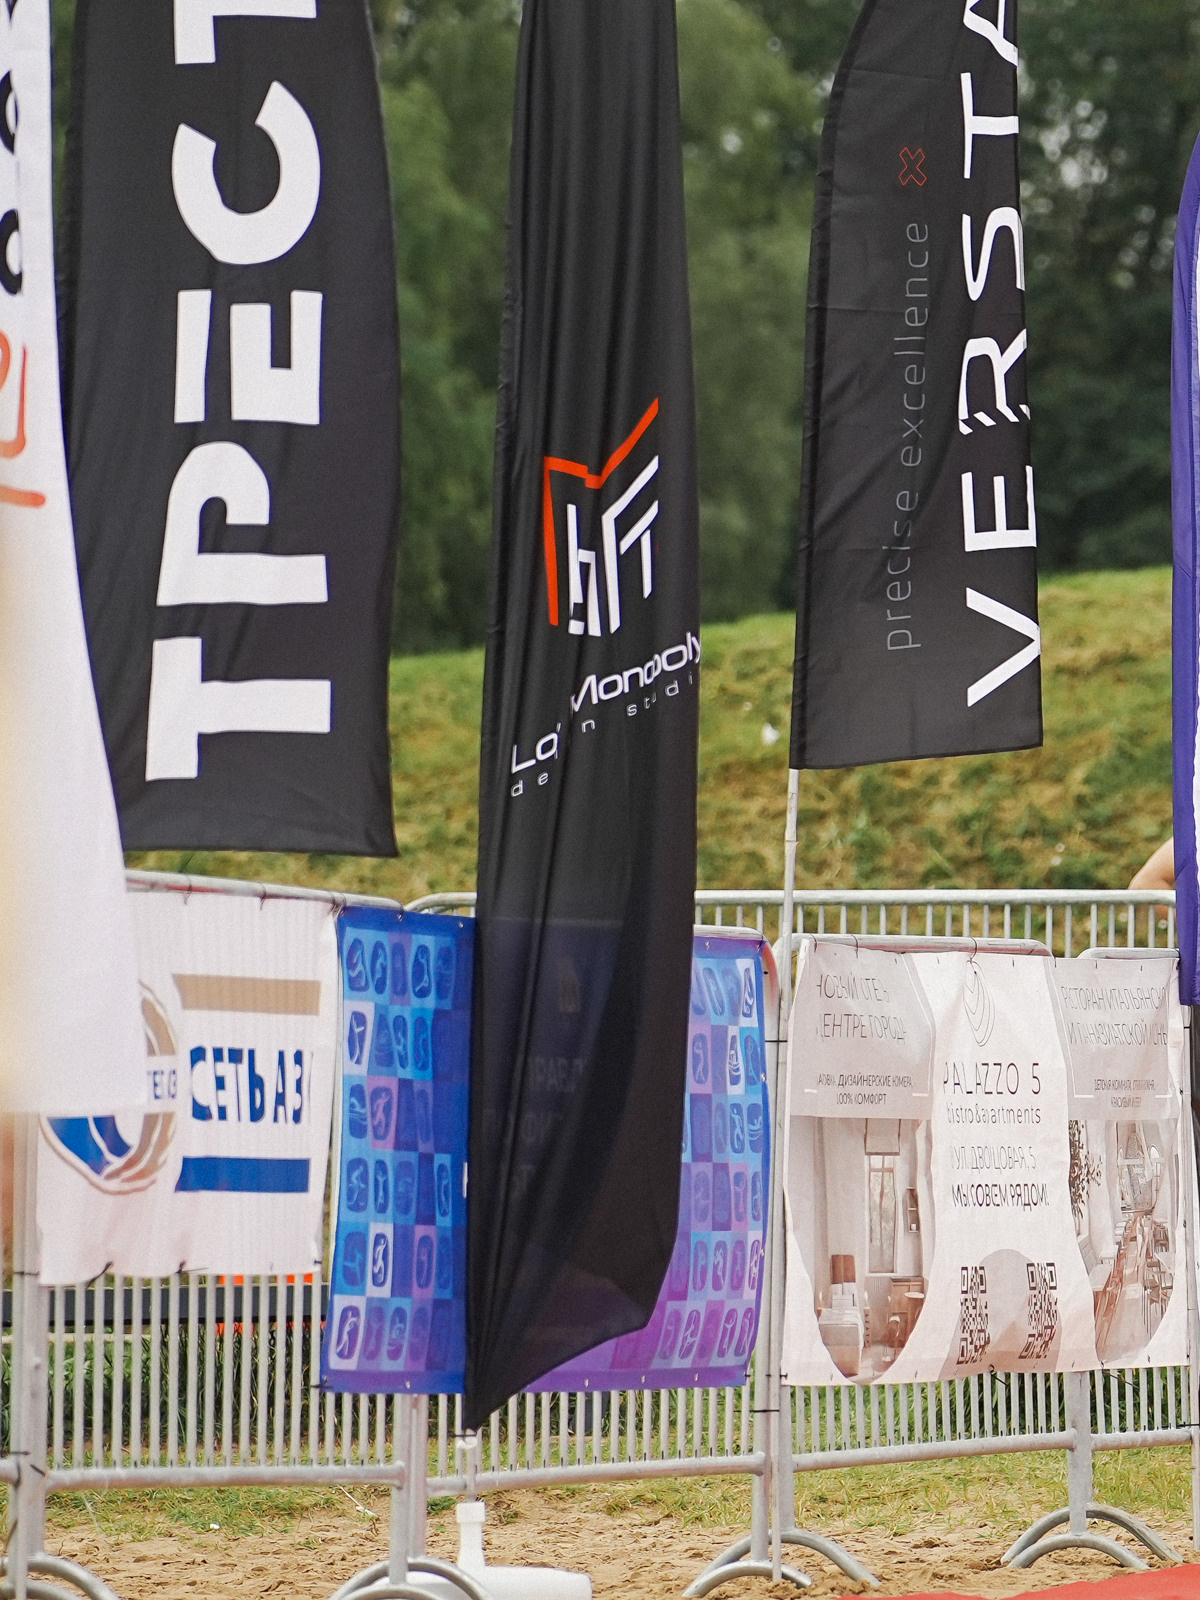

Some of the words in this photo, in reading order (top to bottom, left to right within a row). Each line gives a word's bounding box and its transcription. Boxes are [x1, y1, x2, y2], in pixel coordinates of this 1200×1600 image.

[893, 222, 929, 467] excellence
[883, 489, 921, 651] precise
[943, 1062, 1019, 1095] PALAZZO
[1031, 1062, 1041, 1095] 5
